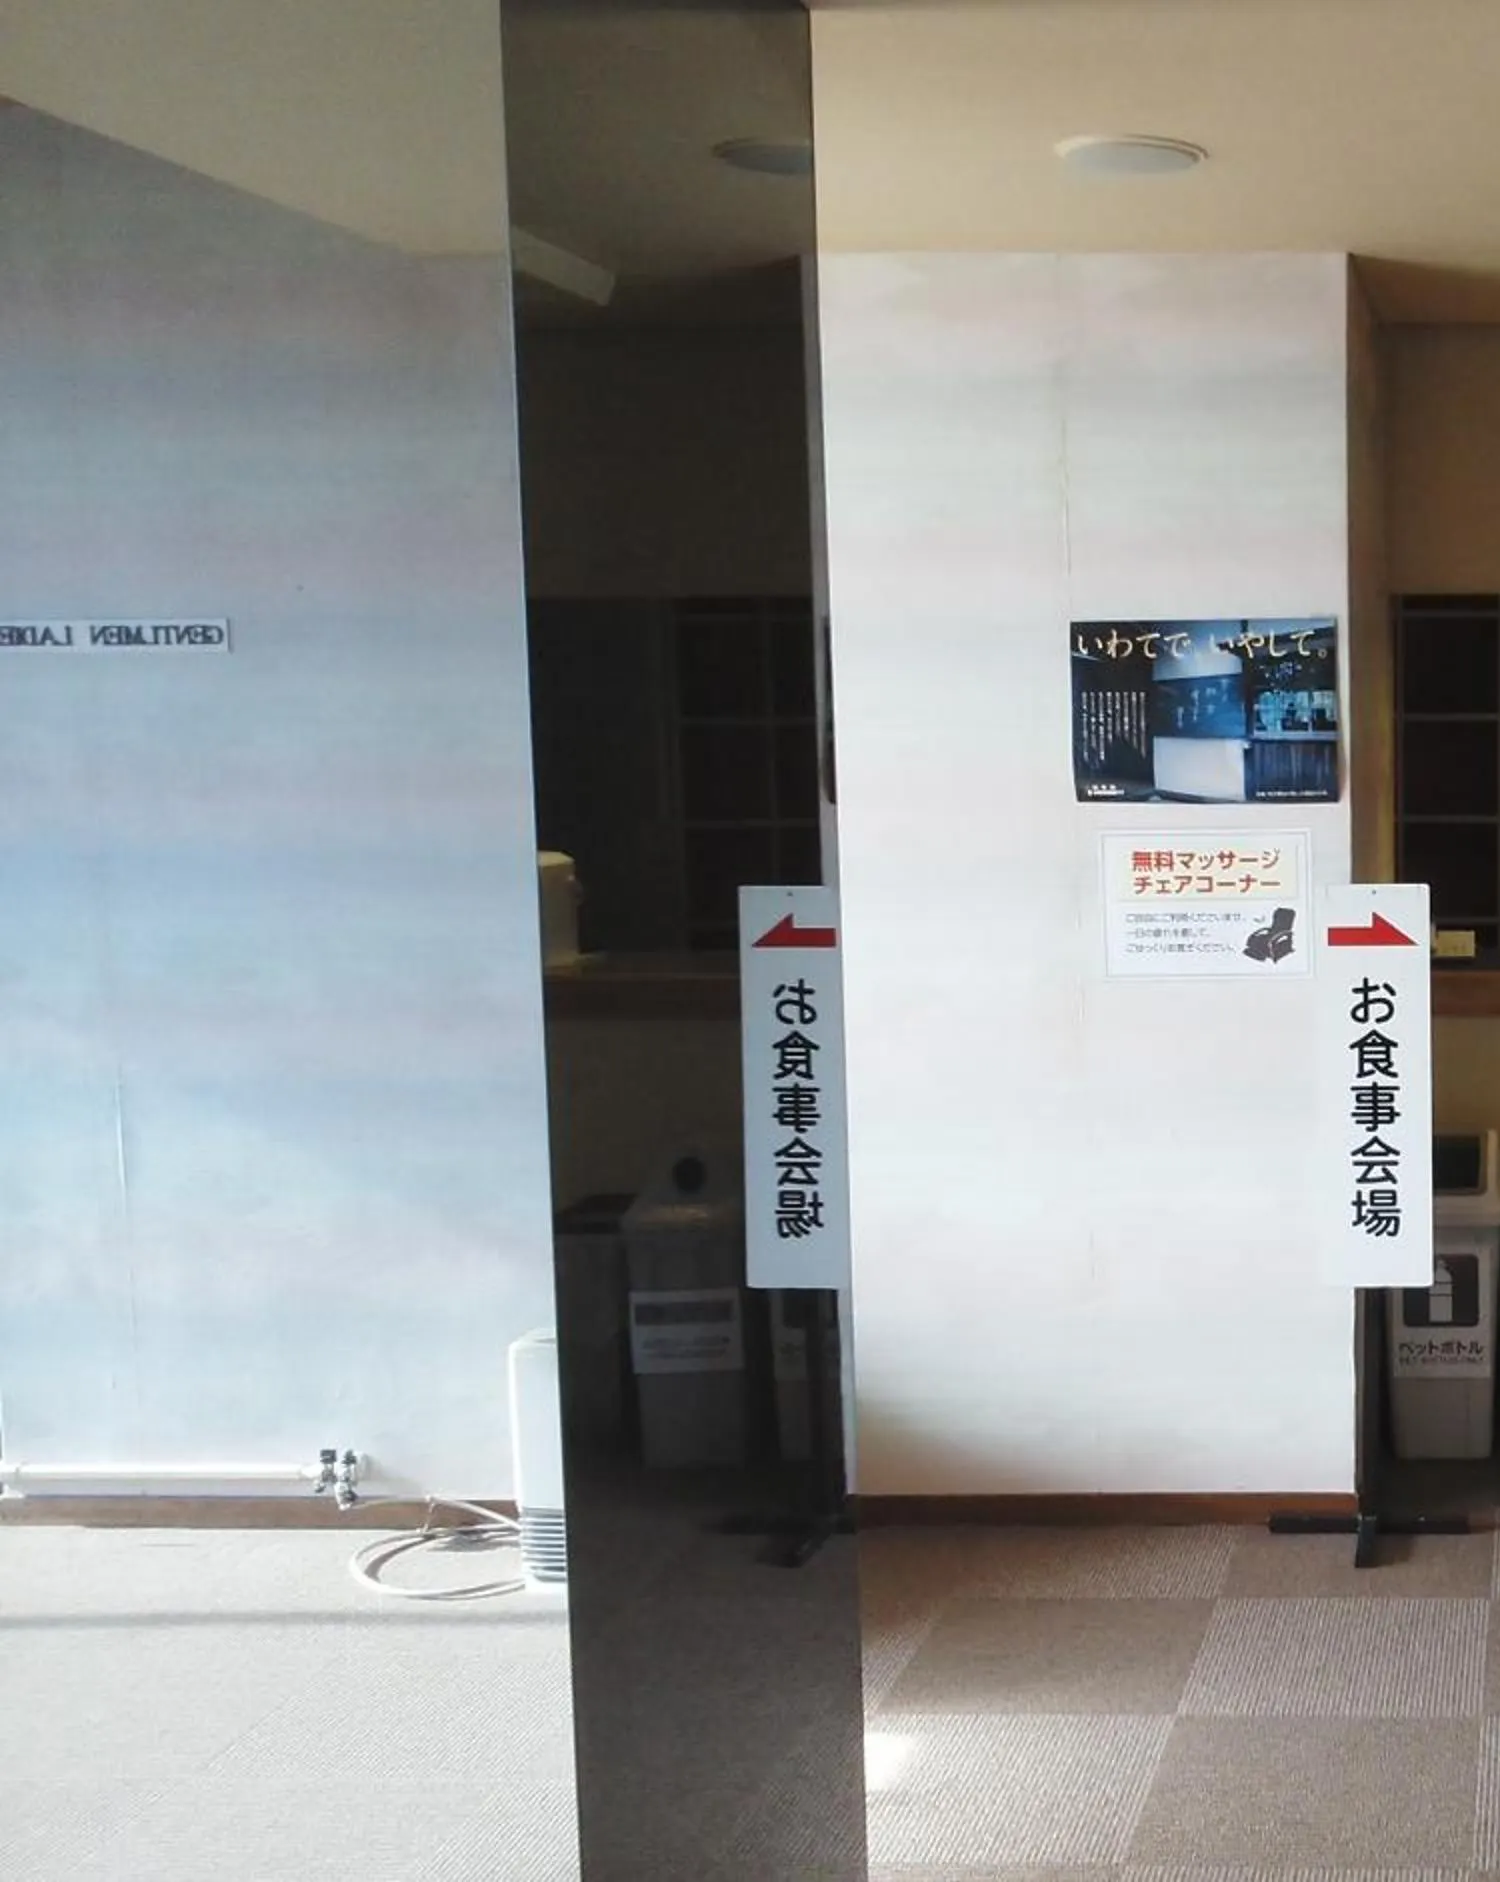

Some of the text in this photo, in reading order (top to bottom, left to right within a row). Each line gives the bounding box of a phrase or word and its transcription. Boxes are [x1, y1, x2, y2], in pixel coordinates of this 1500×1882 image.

[1077, 629, 1328, 659] いわてで いやして。
[1131, 848, 1280, 872] 無料マッサージ
[1133, 874, 1281, 895] チェアコーナー
[1349, 976, 1401, 1238] お食事会場
